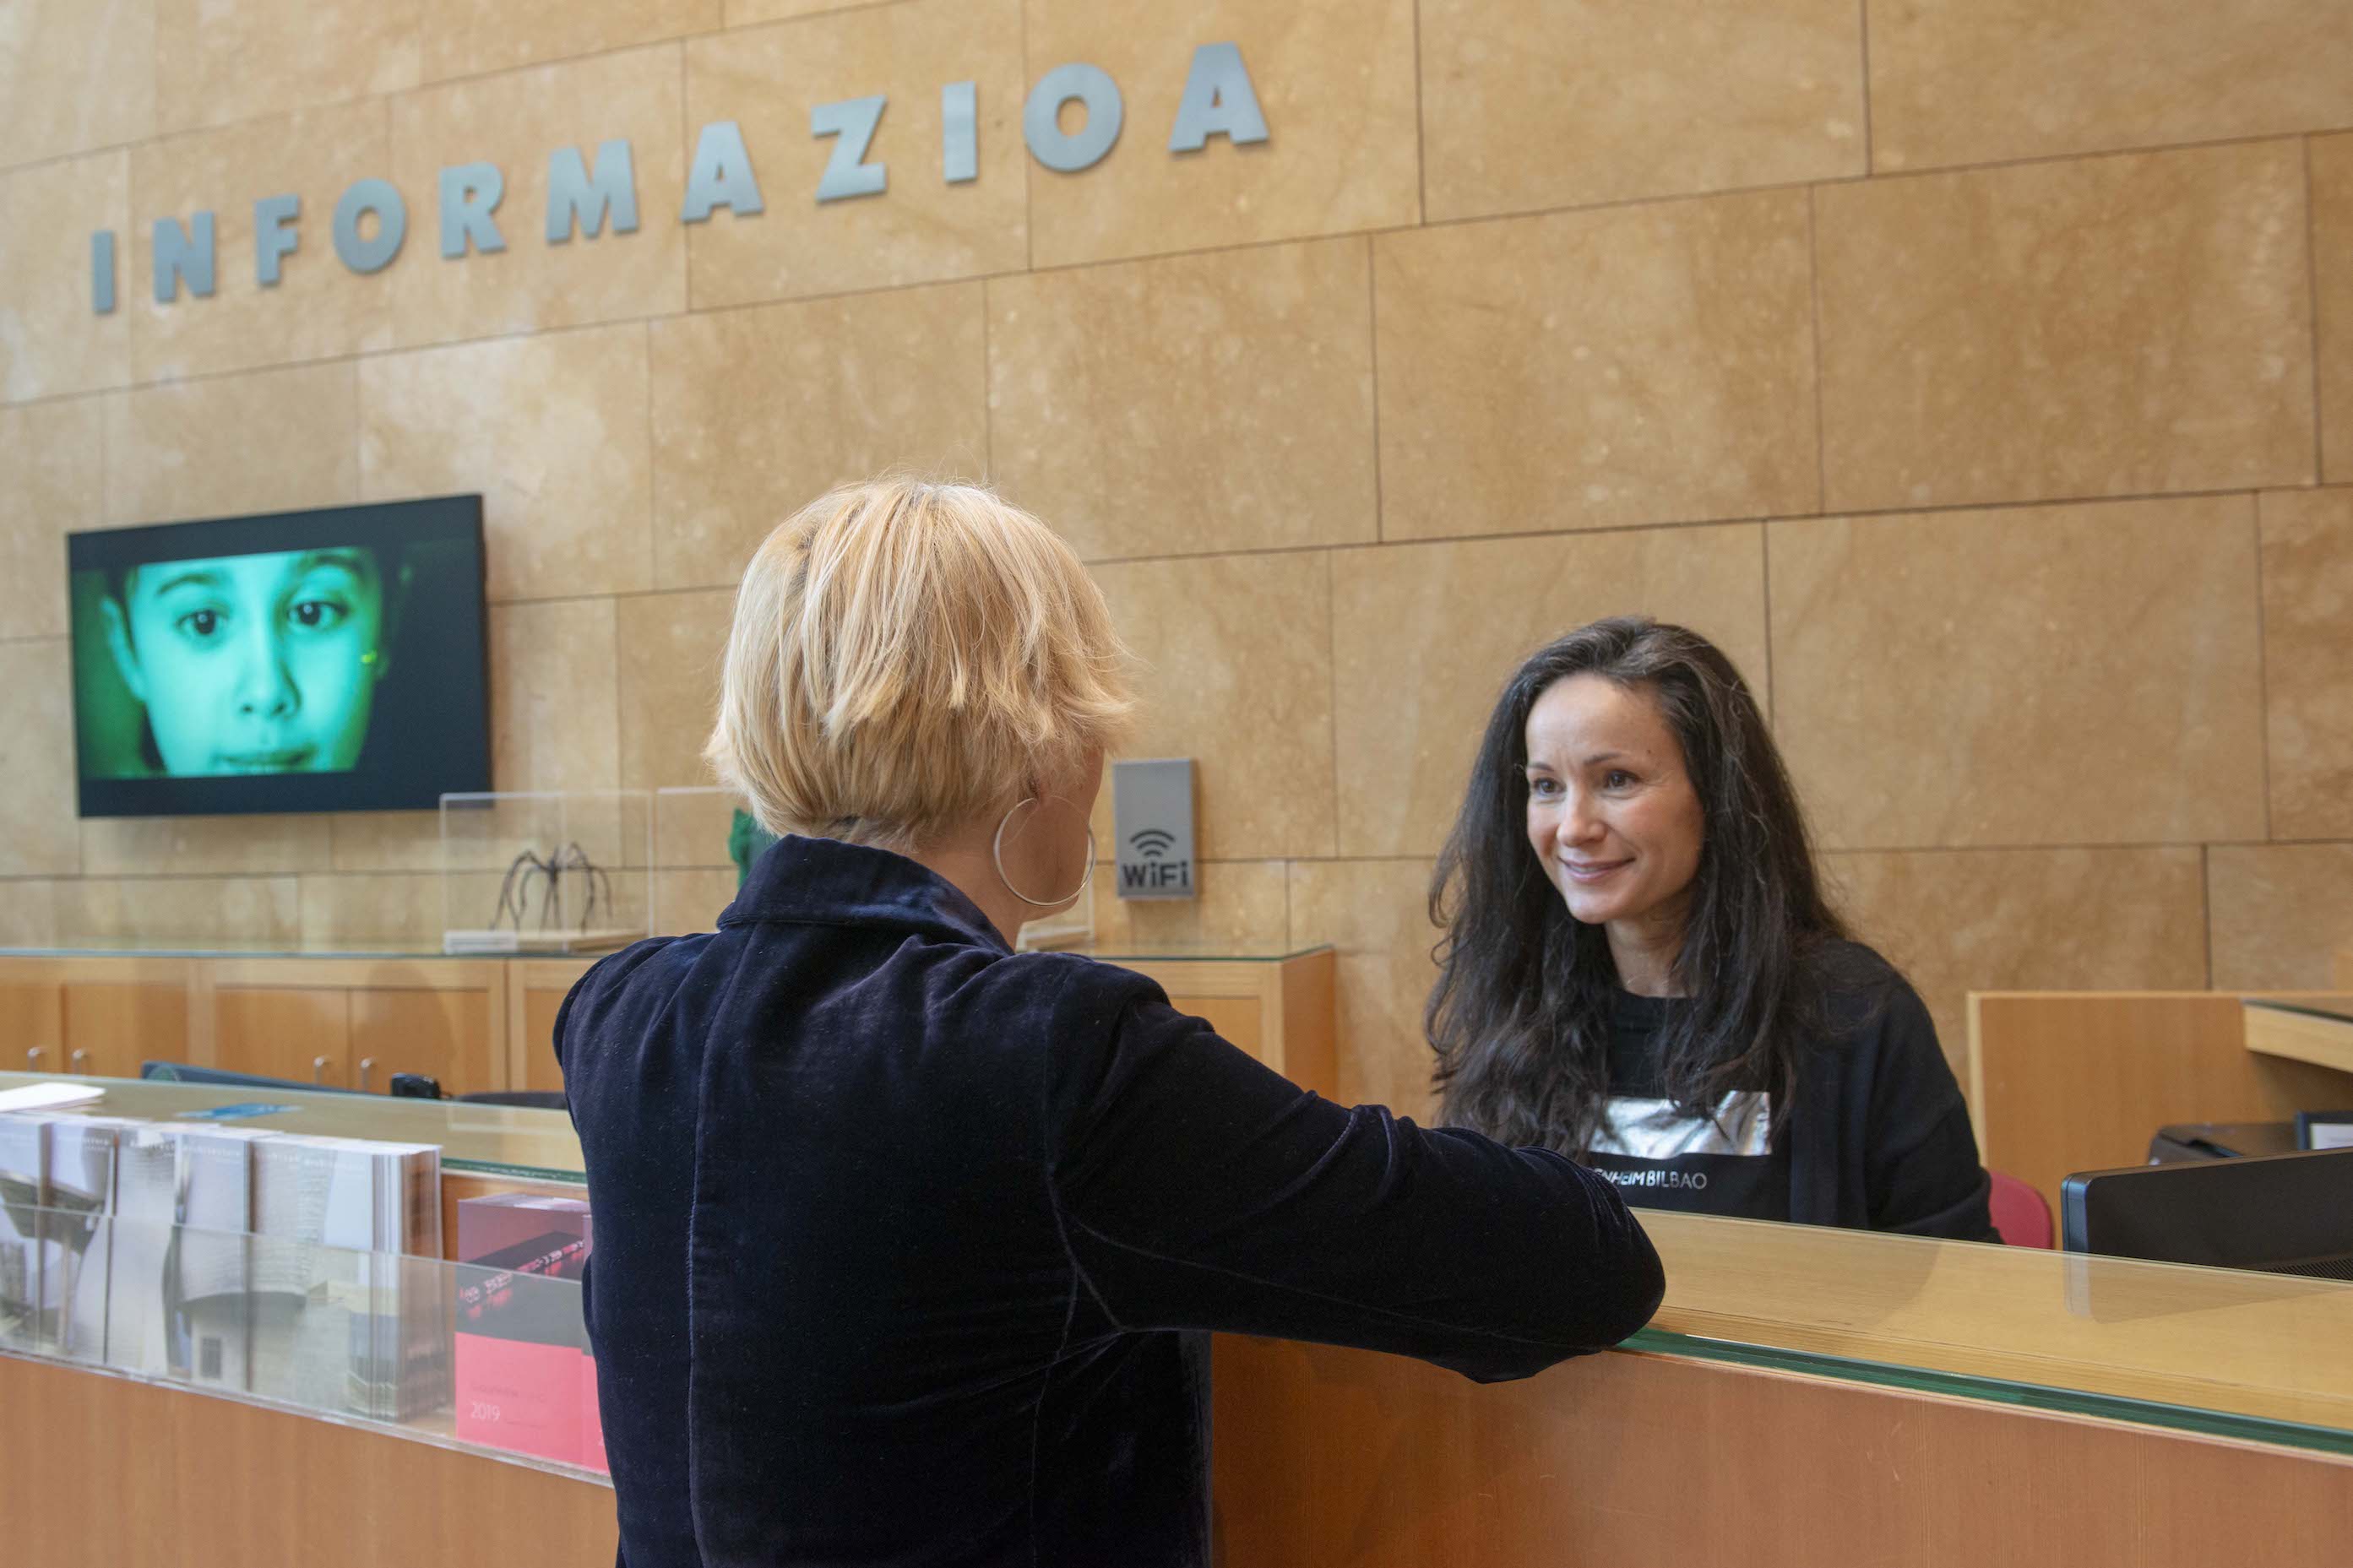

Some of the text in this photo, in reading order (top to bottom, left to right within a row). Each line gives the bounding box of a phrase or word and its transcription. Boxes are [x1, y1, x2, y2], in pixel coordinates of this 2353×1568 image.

[90, 41, 1269, 314] INFORMAZIOA
[1122, 860, 1188, 887] WiFi
[1646, 1169, 1708, 1190] BILBAO
[470, 1402, 501, 1422] 2019
